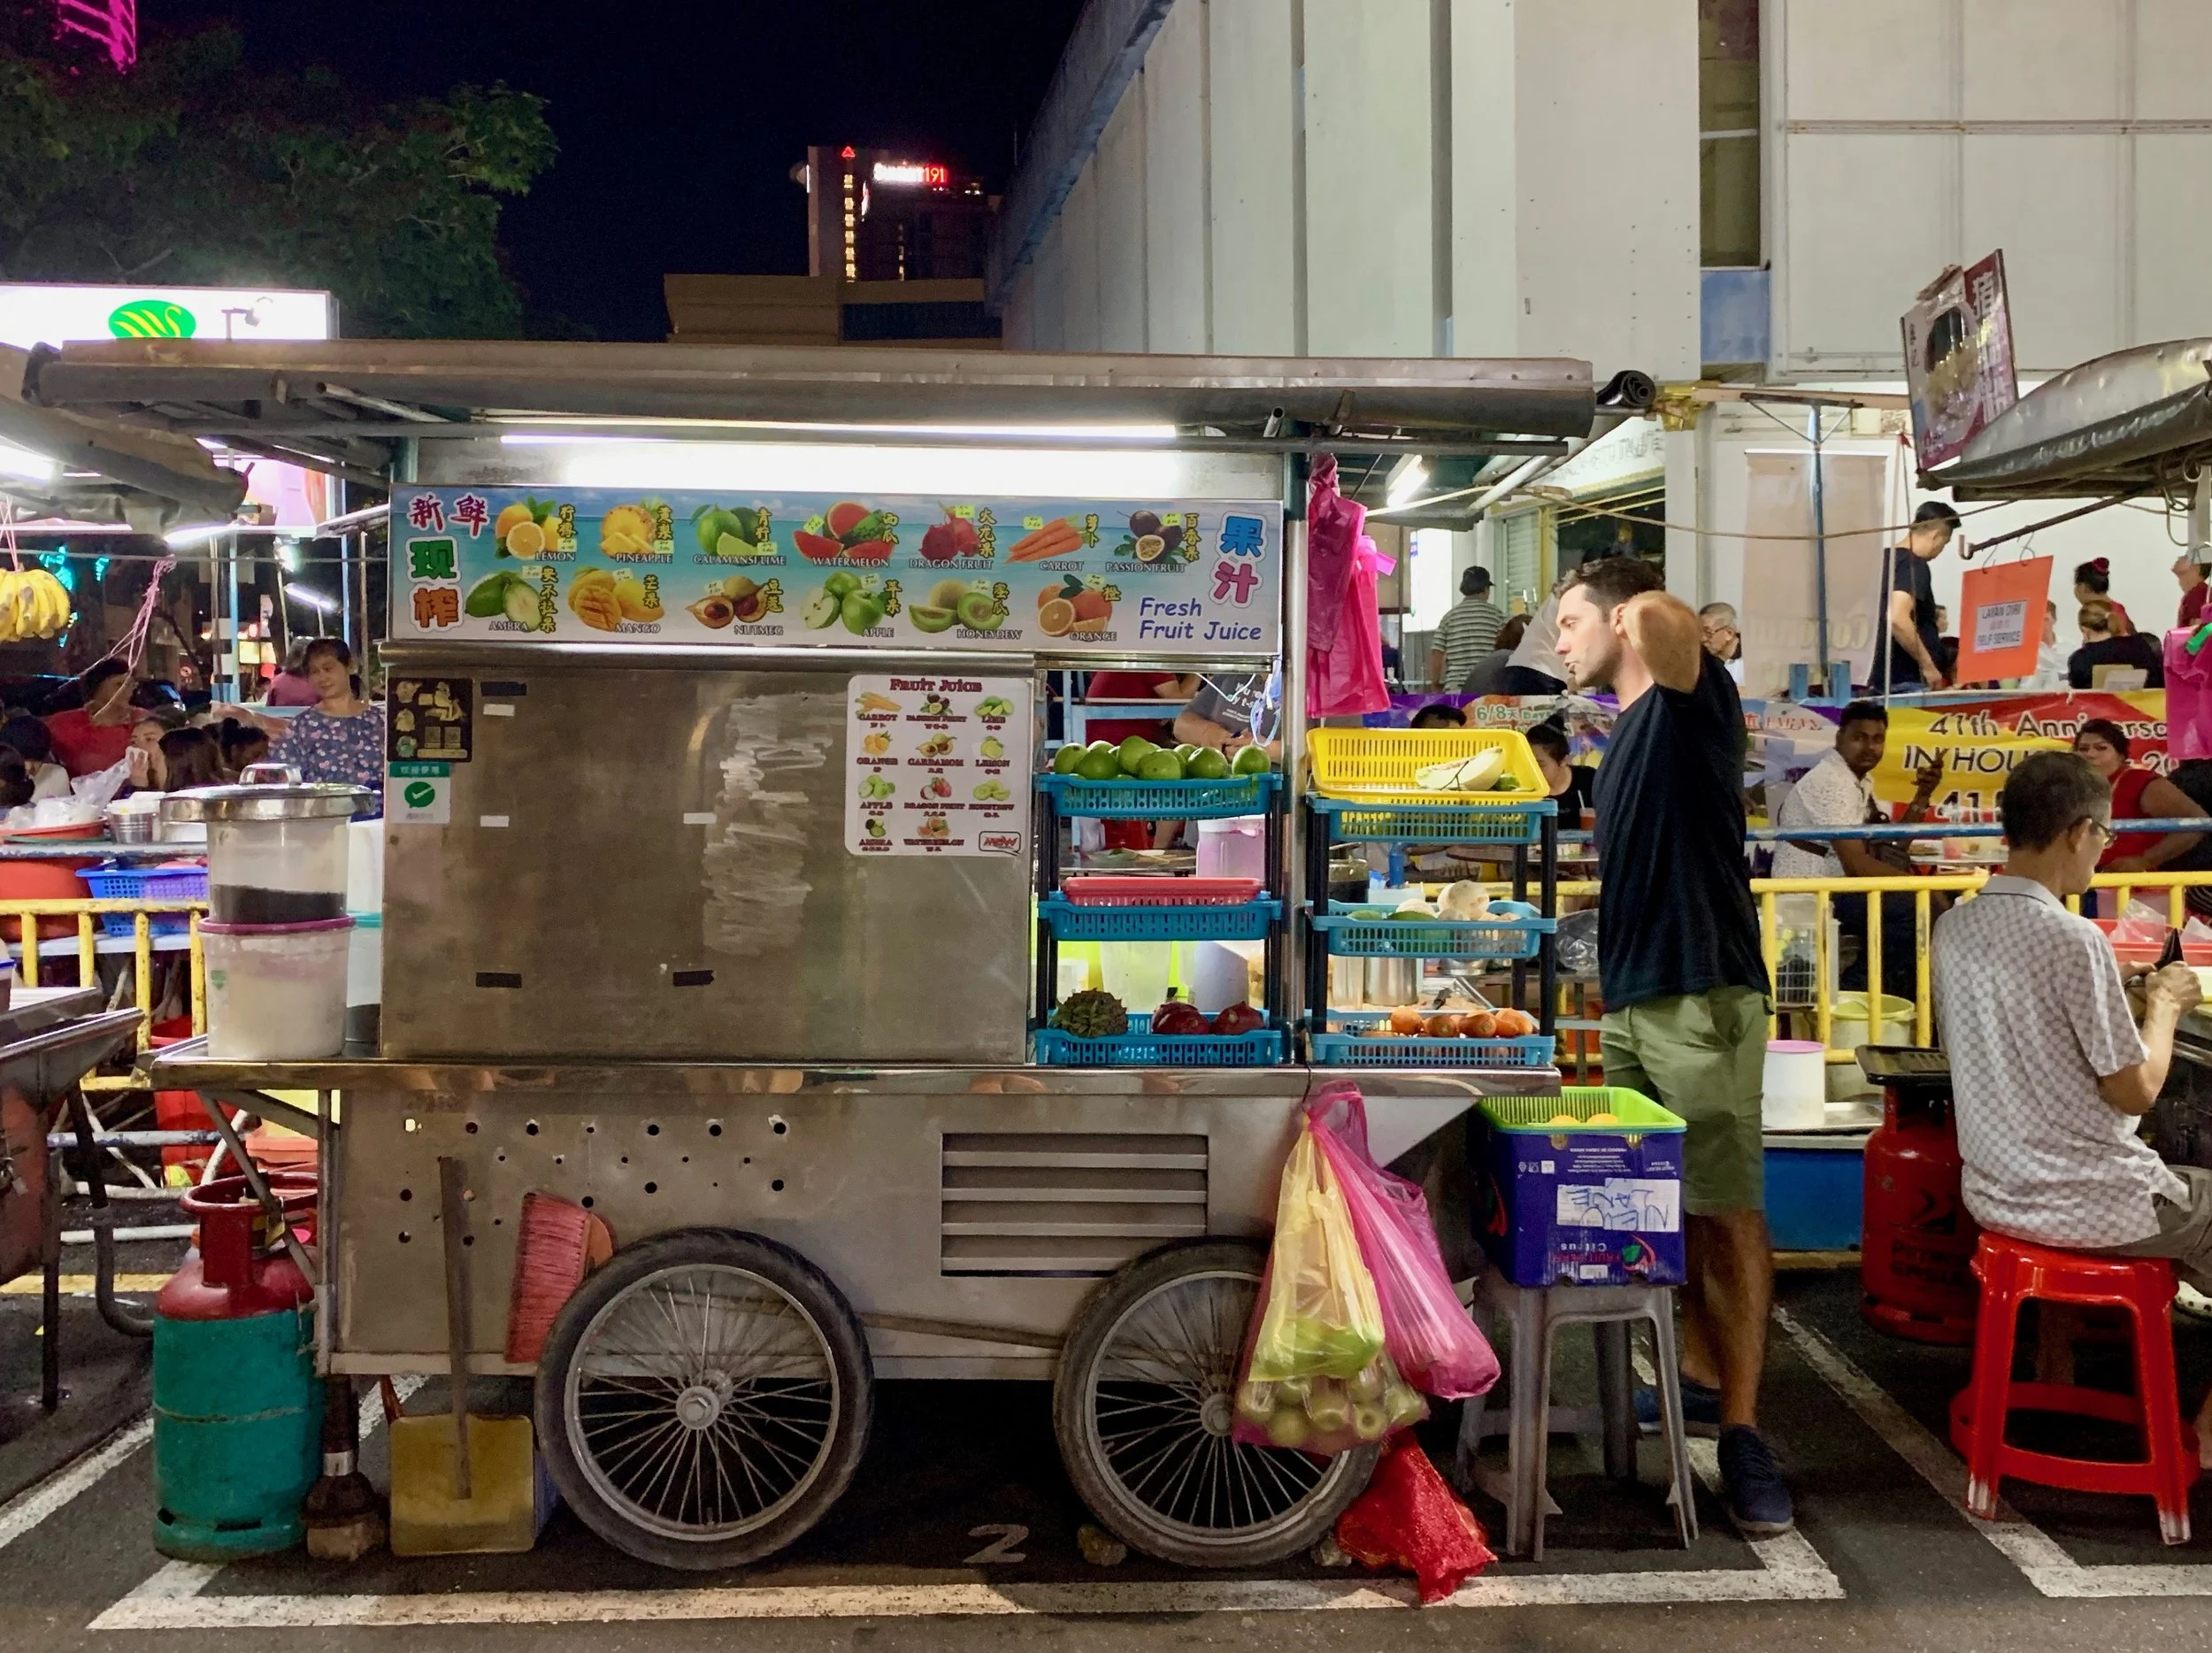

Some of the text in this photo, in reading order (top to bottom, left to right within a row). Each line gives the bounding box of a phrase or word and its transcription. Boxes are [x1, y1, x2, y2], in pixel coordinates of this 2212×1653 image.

[926, 167, 945, 182] 191
[410, 495, 489, 538] 新鲜
[756, 506, 772, 542] 青柠
[882, 511, 899, 544] 西瓜
[978, 507, 997, 558] 火龙果
[1183, 512, 1202, 562] 百香果
[535, 551, 575, 562] LEMON
[616, 552, 672, 563] PINEAPPLE
[693, 554, 786, 565] CALAMANSI LIME
[812, 556, 889, 567] WATERMELON
[1213, 515, 1263, 604] 果汁
[909, 558, 994, 570] DRAGON FRUIT
[1039, 561, 1084, 571] CARROT
[1106, 562, 1186, 573] PASSION FRUIT
[644, 574, 661, 609] 芒果
[885, 579, 902, 617] 苹果
[992, 581, 1010, 617] 蜜瓜
[1139, 596, 1203, 617] Fresh
[488, 621, 529, 632] AMBRA
[615, 623, 661, 634] MANGO
[733, 625, 784, 636] NUTMEG
[862, 627, 895, 637] APPLE
[1139, 619, 1263, 641] Fruit Juice
[957, 629, 1023, 639] HONEYDEW
[1070, 631, 1117, 642] ORANGE
[857, 713, 898, 722] CARROT
[856, 757, 898, 765] ORANGE
[1566, 1188, 1655, 1209] LANE
[962, 1523, 1030, 1565] 2
